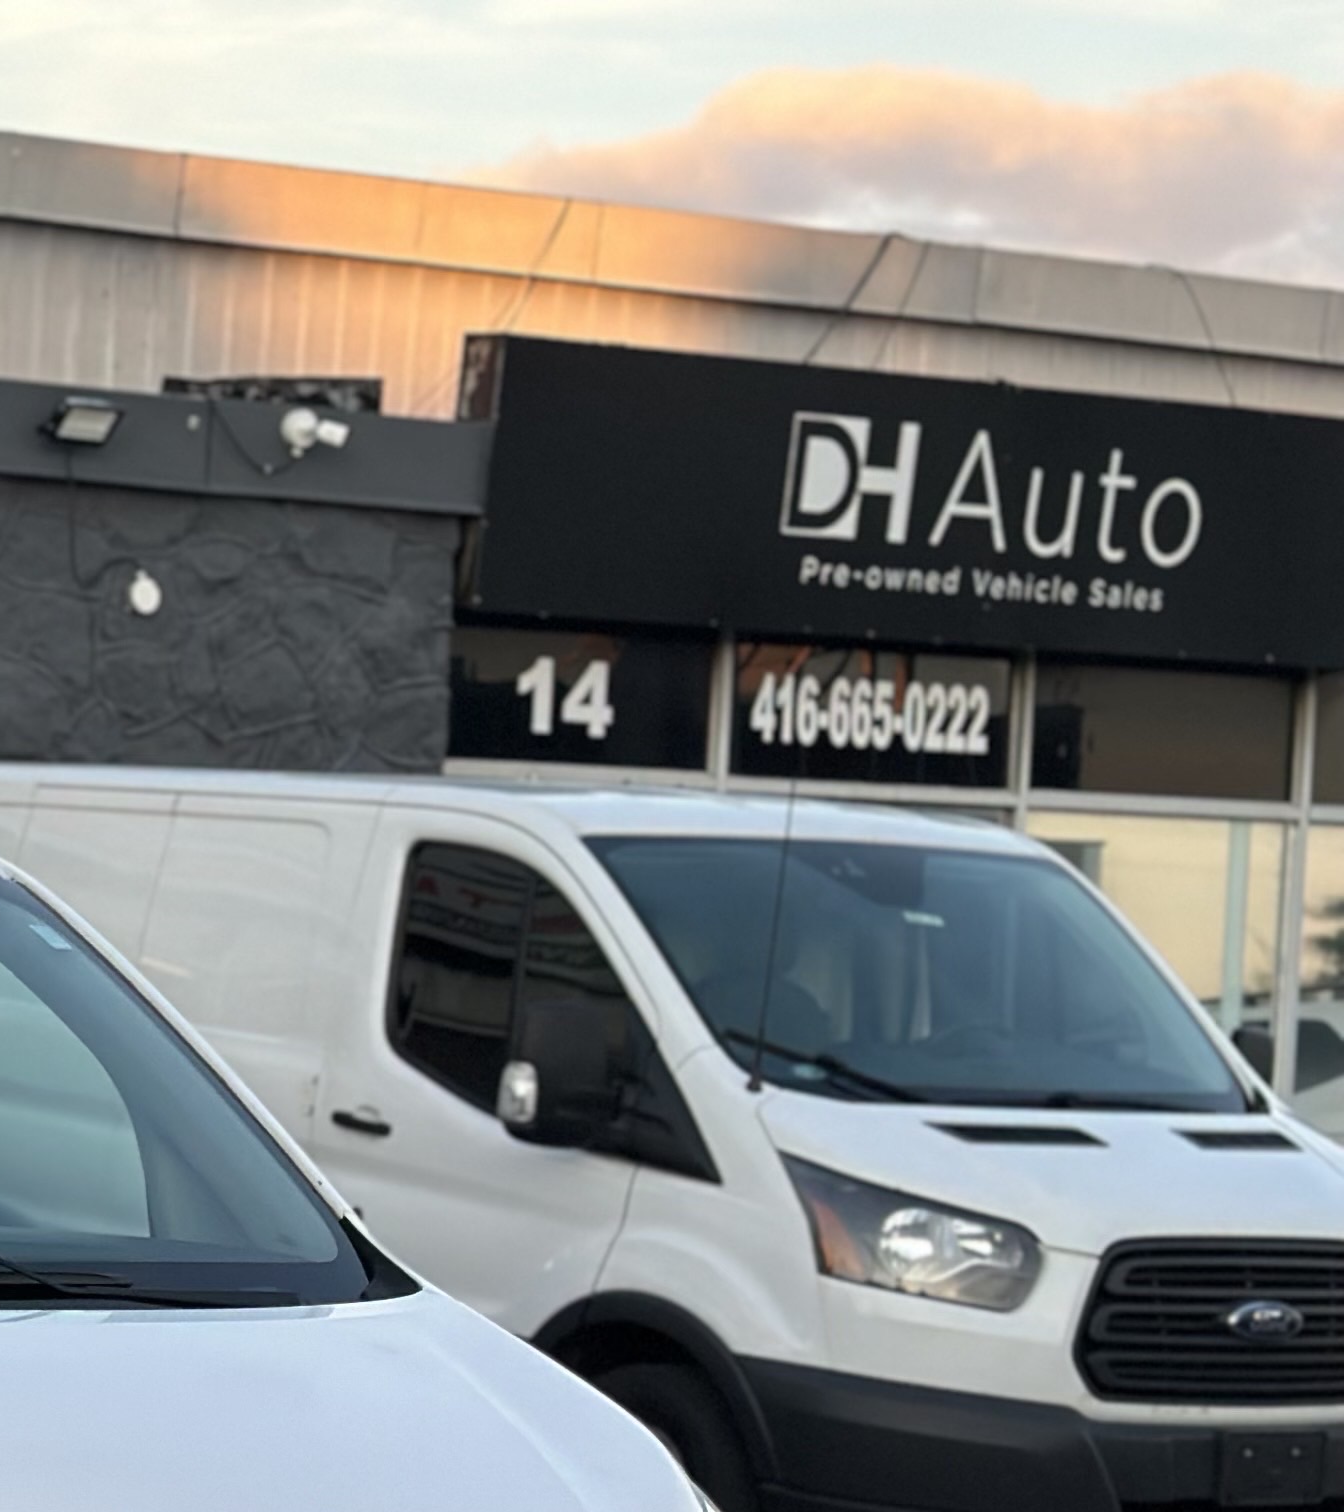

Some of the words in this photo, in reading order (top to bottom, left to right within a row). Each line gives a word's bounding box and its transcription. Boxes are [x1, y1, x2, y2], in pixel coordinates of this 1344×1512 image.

[779, 411, 922, 545] DH
[928, 429, 1203, 568] Auto
[799, 554, 962, 596] Pre-owned
[972, 567, 1078, 606] Vehicle
[1088, 577, 1165, 613] Sales
[517, 655, 615, 739] 14
[750, 671, 990, 755] 416-665-0222
